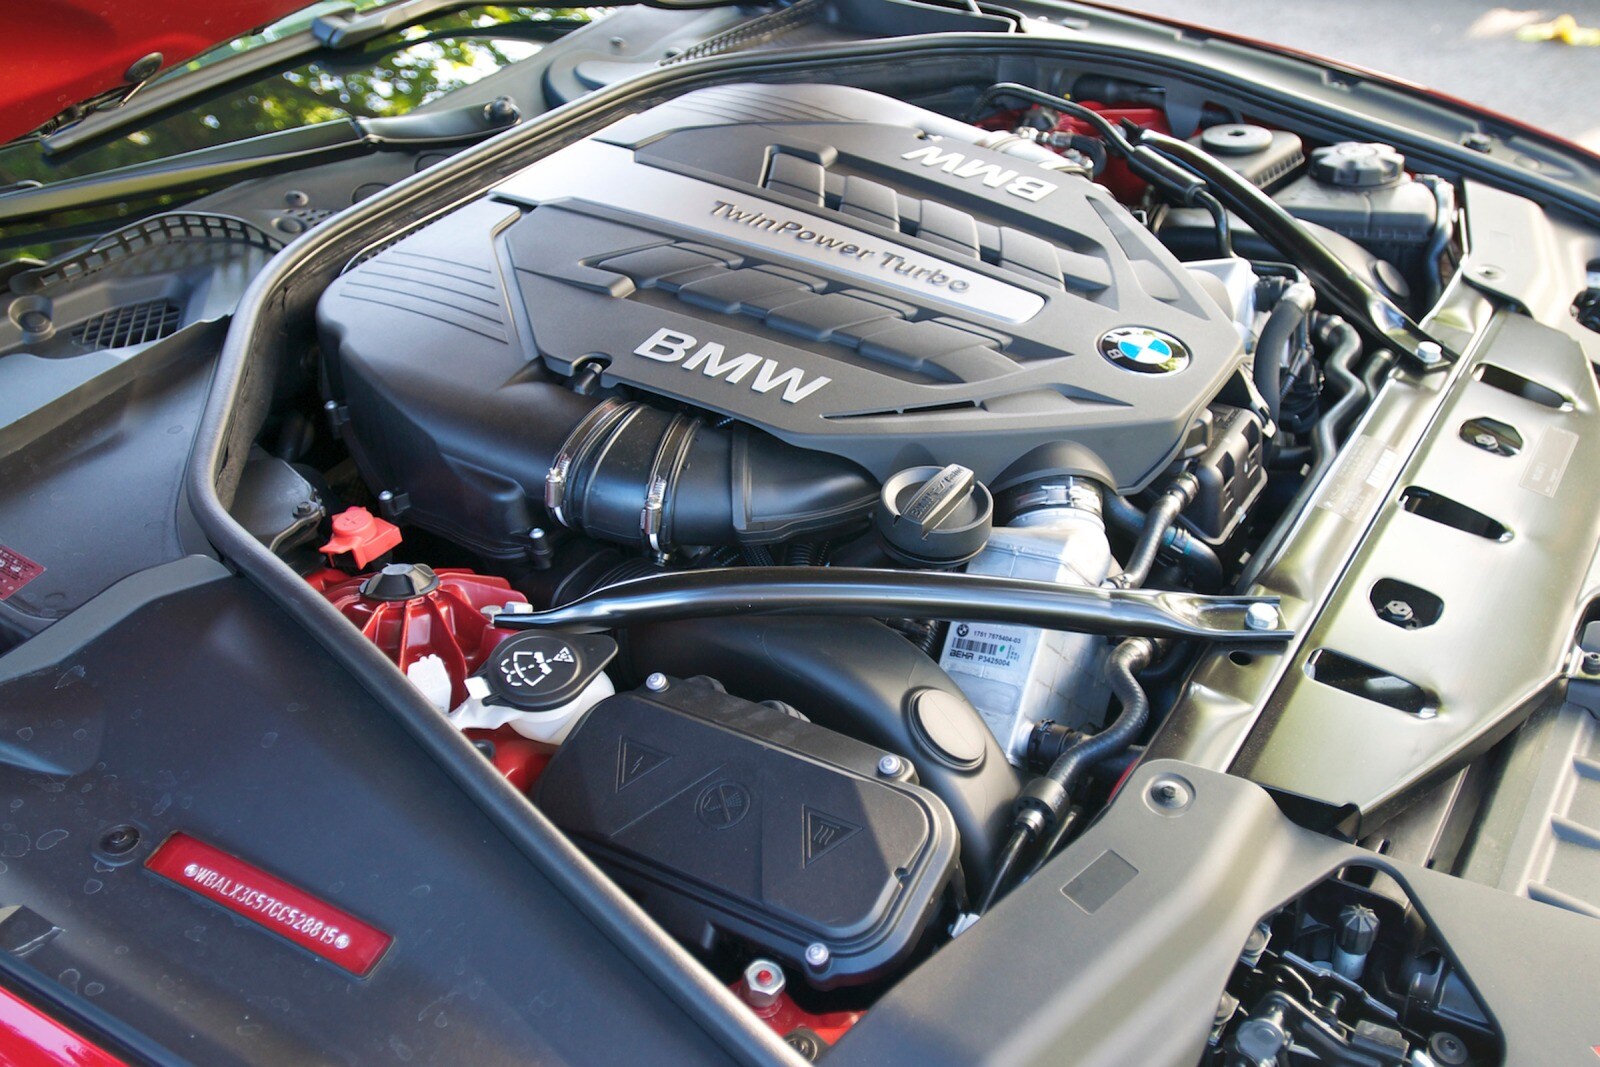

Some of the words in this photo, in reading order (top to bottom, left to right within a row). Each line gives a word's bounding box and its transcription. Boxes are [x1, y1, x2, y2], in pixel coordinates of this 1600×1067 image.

[902, 145, 1058, 202] BMW
[712, 200, 875, 261] TwinPower
[880, 251, 970, 294] Turbo
[633, 327, 832, 404] BMW
[949, 649, 974, 660] BEHR
[193, 867, 339, 945] WBALX3C57CC528815
